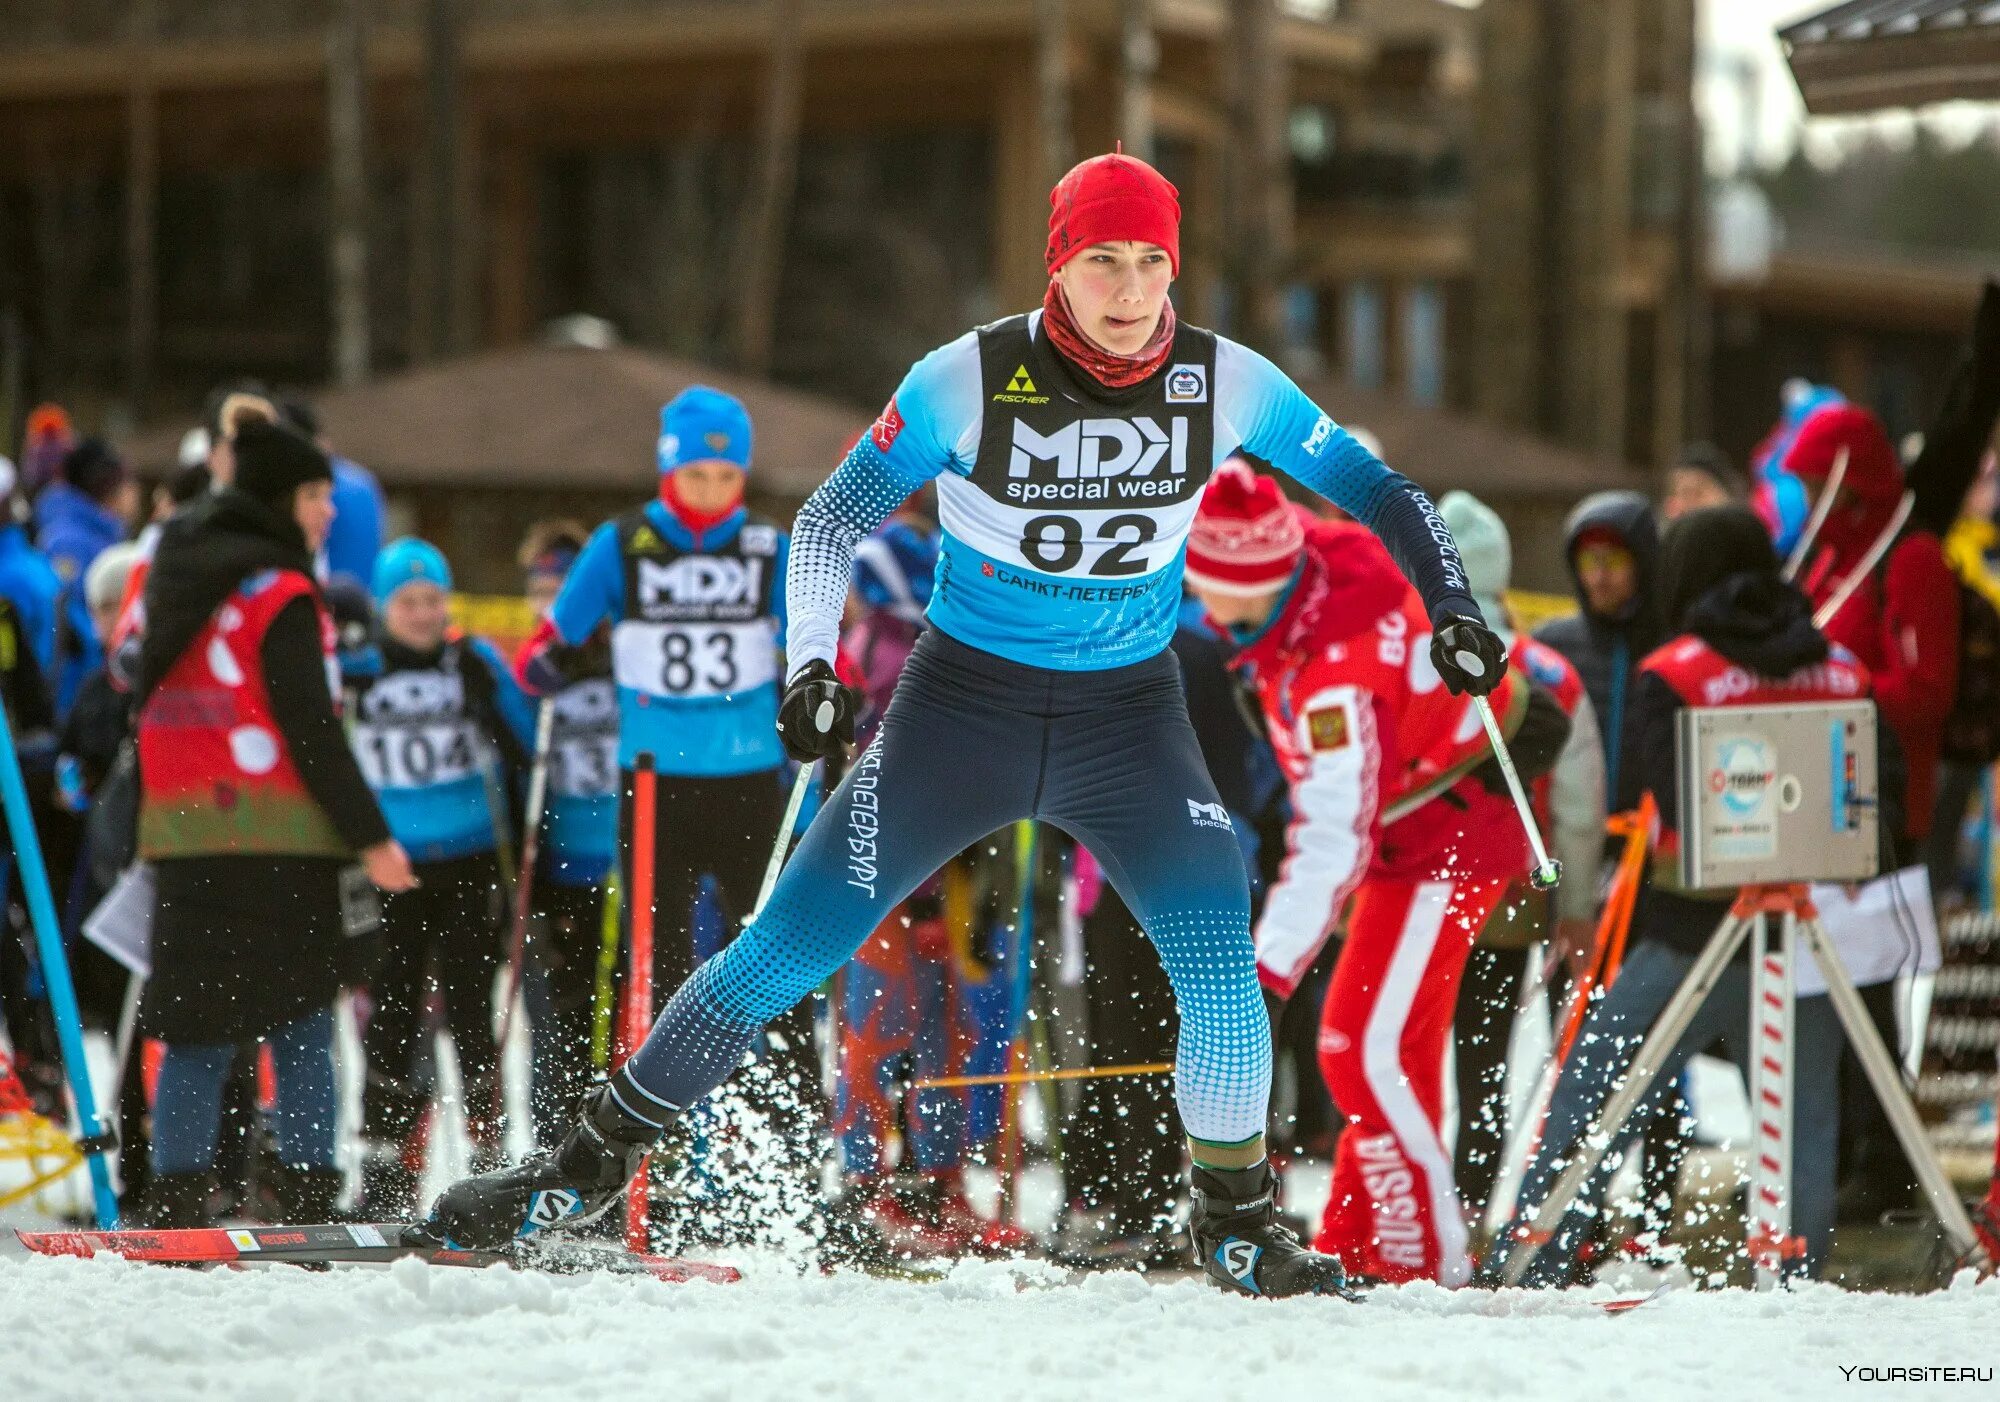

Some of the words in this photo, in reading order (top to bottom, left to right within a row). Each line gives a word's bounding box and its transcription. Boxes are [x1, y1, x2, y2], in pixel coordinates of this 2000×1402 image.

[992, 394, 1050, 405] FISCHER
[1007, 477, 1110, 502] special
[1118, 477, 1186, 497] wear
[1020, 513, 1158, 576] 82
[661, 632, 737, 692] 83
[371, 734, 472, 784] 104
[1192, 818, 1231, 832] special
[1355, 1131, 1426, 1268] RUSSIA
